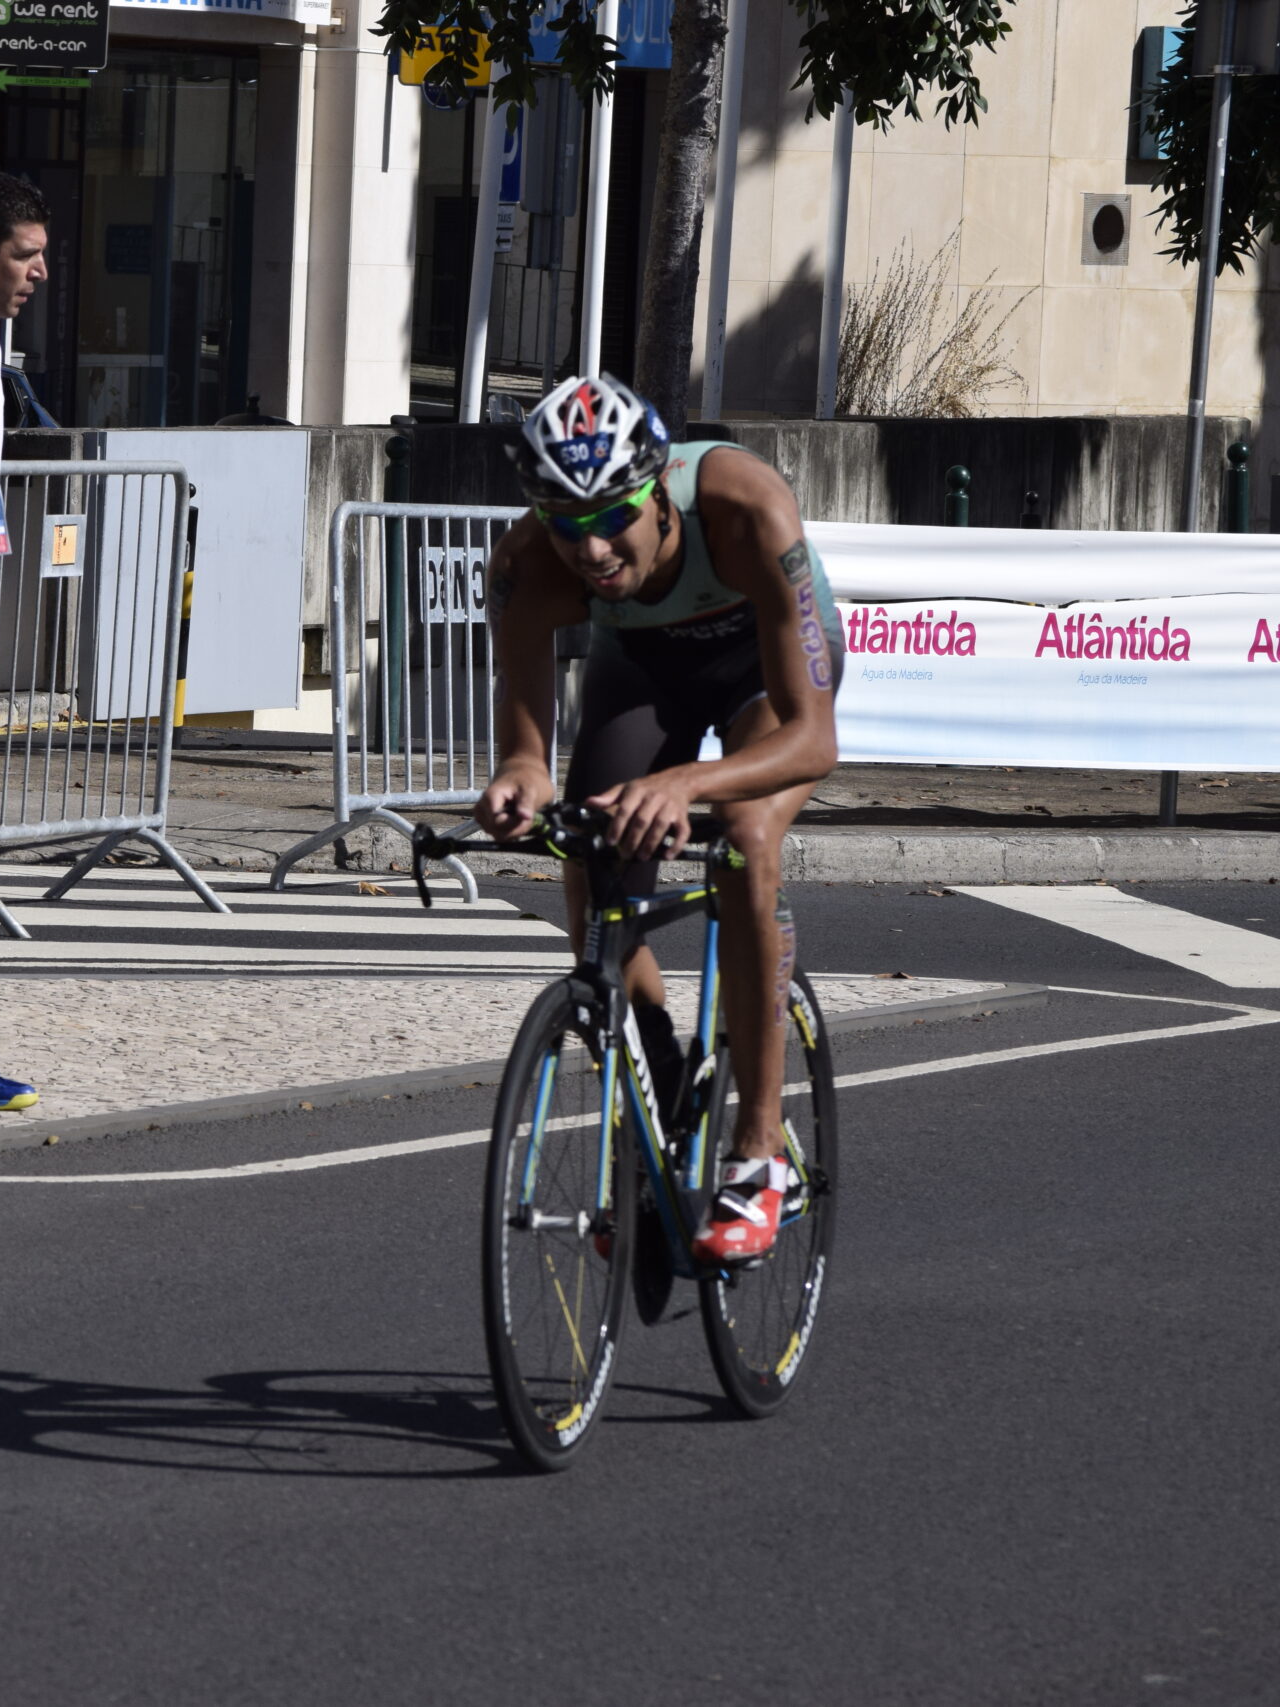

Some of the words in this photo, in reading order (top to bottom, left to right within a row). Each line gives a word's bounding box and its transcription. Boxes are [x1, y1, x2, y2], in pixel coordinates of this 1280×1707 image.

[13, 3, 46, 17] we
[51, 1, 99, 19] rent
[1035, 612, 1191, 662] Atlântida
[861, 665, 884, 683] Água
[886, 669, 897, 680] da
[898, 669, 934, 681] Madeira
[1077, 671, 1100, 687] Água
[1101, 672, 1112, 684] da
[1113, 672, 1147, 685] Madeira
